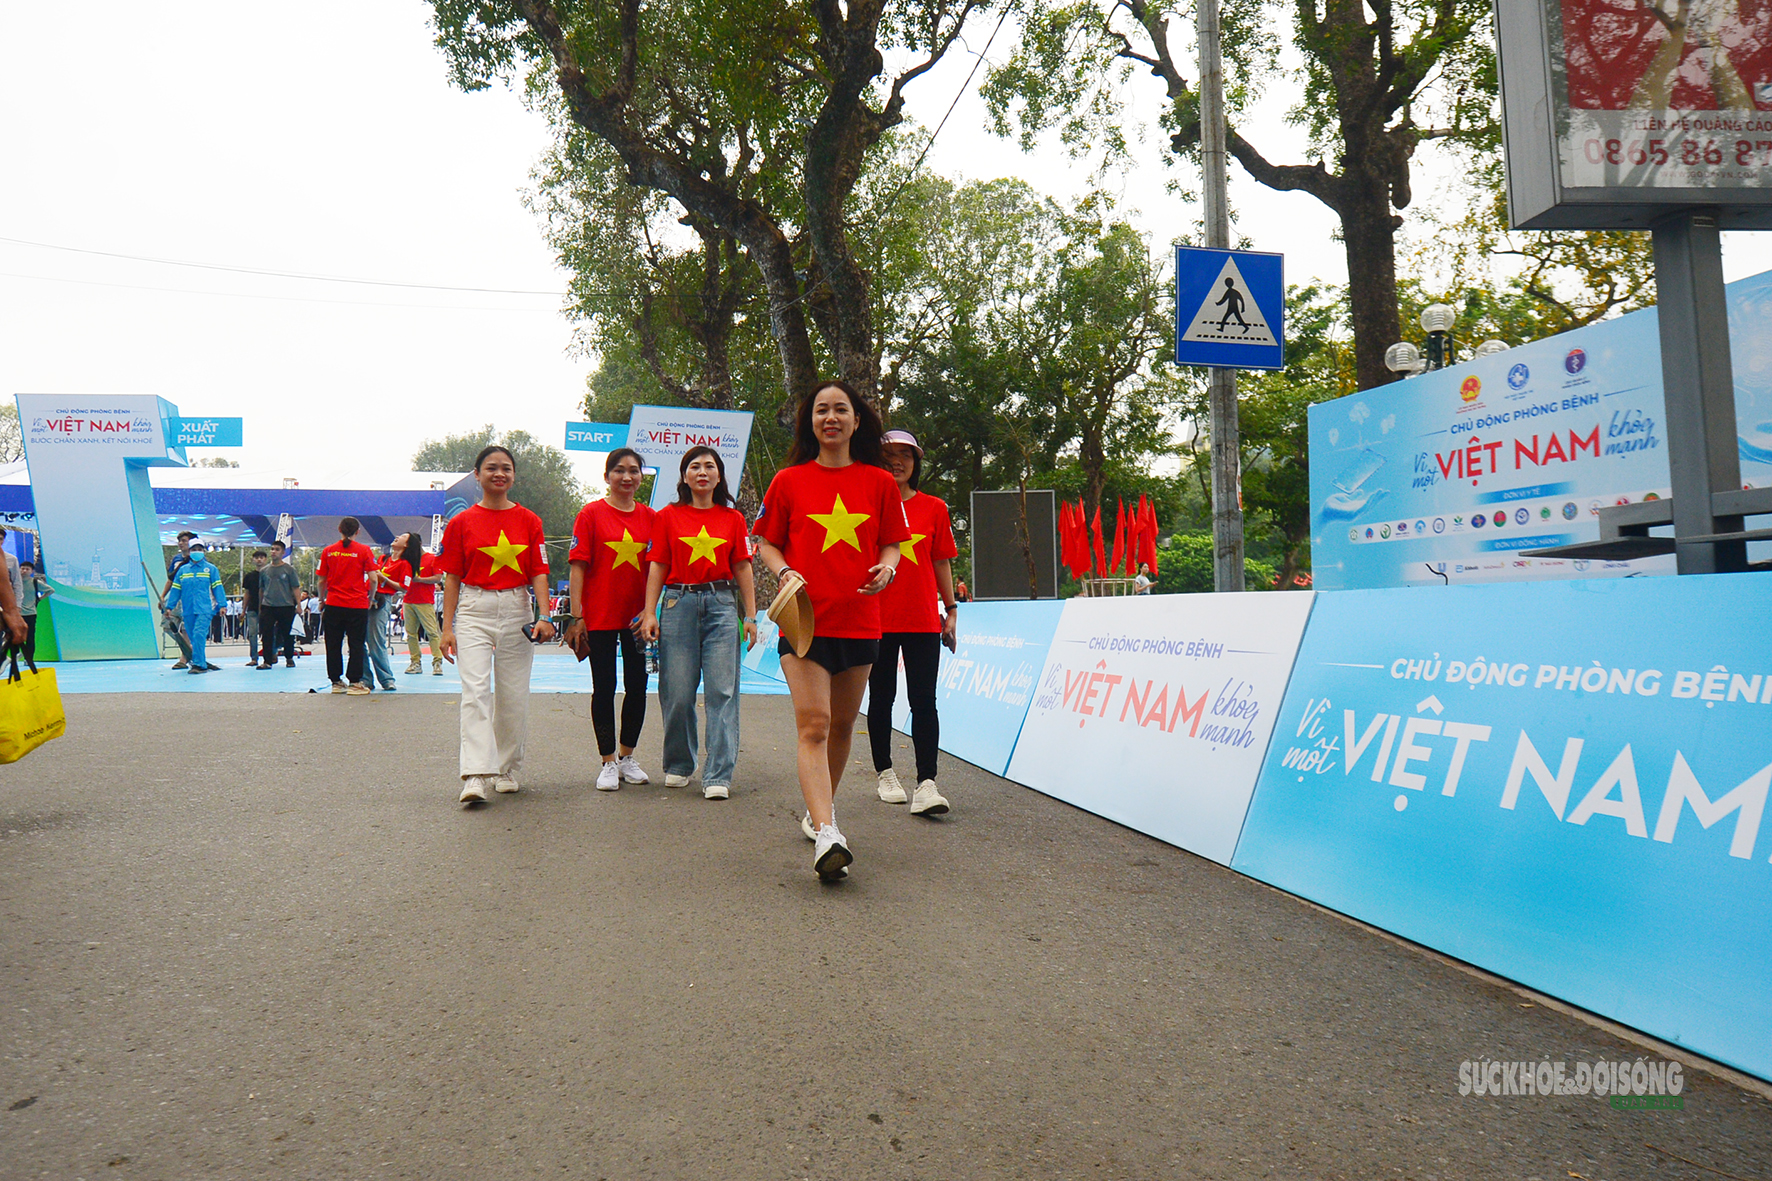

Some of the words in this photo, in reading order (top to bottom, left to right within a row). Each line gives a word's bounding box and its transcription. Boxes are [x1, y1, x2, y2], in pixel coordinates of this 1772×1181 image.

[1635, 117, 1666, 130] LIÊN
[1693, 117, 1743, 131] QUẢNG
[1745, 118, 1772, 132] CÁO
[1584, 138, 1669, 166] 0865
[1681, 139, 1723, 166] 86
[1735, 140, 1772, 166] 87
[46, 415, 85, 436] VIỆT
[90, 419, 130, 432] NAM
[181, 420, 219, 432] XUẤT
[1450, 417, 1473, 435] CHỦ
[1476, 413, 1510, 430] ĐỘNG
[1513, 403, 1558, 421] PHÒNG
[1563, 394, 1599, 412] BỆNH
[178, 431, 215, 443] PHÁT
[568, 431, 613, 443] START
[648, 428, 681, 447] VIỆT
[685, 433, 720, 447] NAM
[1435, 436, 1503, 486] VIỆT
[1514, 424, 1600, 469] NAM
[1089, 633, 1110, 650] CHỦ
[1110, 635, 1141, 655] ĐỘNG
[1141, 636, 1184, 656] PHÒNG
[1185, 638, 1224, 661] BỆNH
[940, 650, 974, 699] VIỆT
[967, 662, 1014, 702] NAM
[1391, 652, 1442, 681] CHỦ
[1446, 656, 1530, 690] ĐỘNG
[1534, 660, 1663, 696] PHÒNG
[1062, 658, 1123, 728] VIỆT
[1119, 677, 1210, 738] NAM
[1210, 677, 1260, 720] khỏe
[1199, 713, 1258, 751] mạnh
[1281, 736, 1340, 782] một
[1296, 697, 1332, 739] Vì
[1343, 694, 1492, 812] VIỆT
[1499, 728, 1772, 865] NAM
